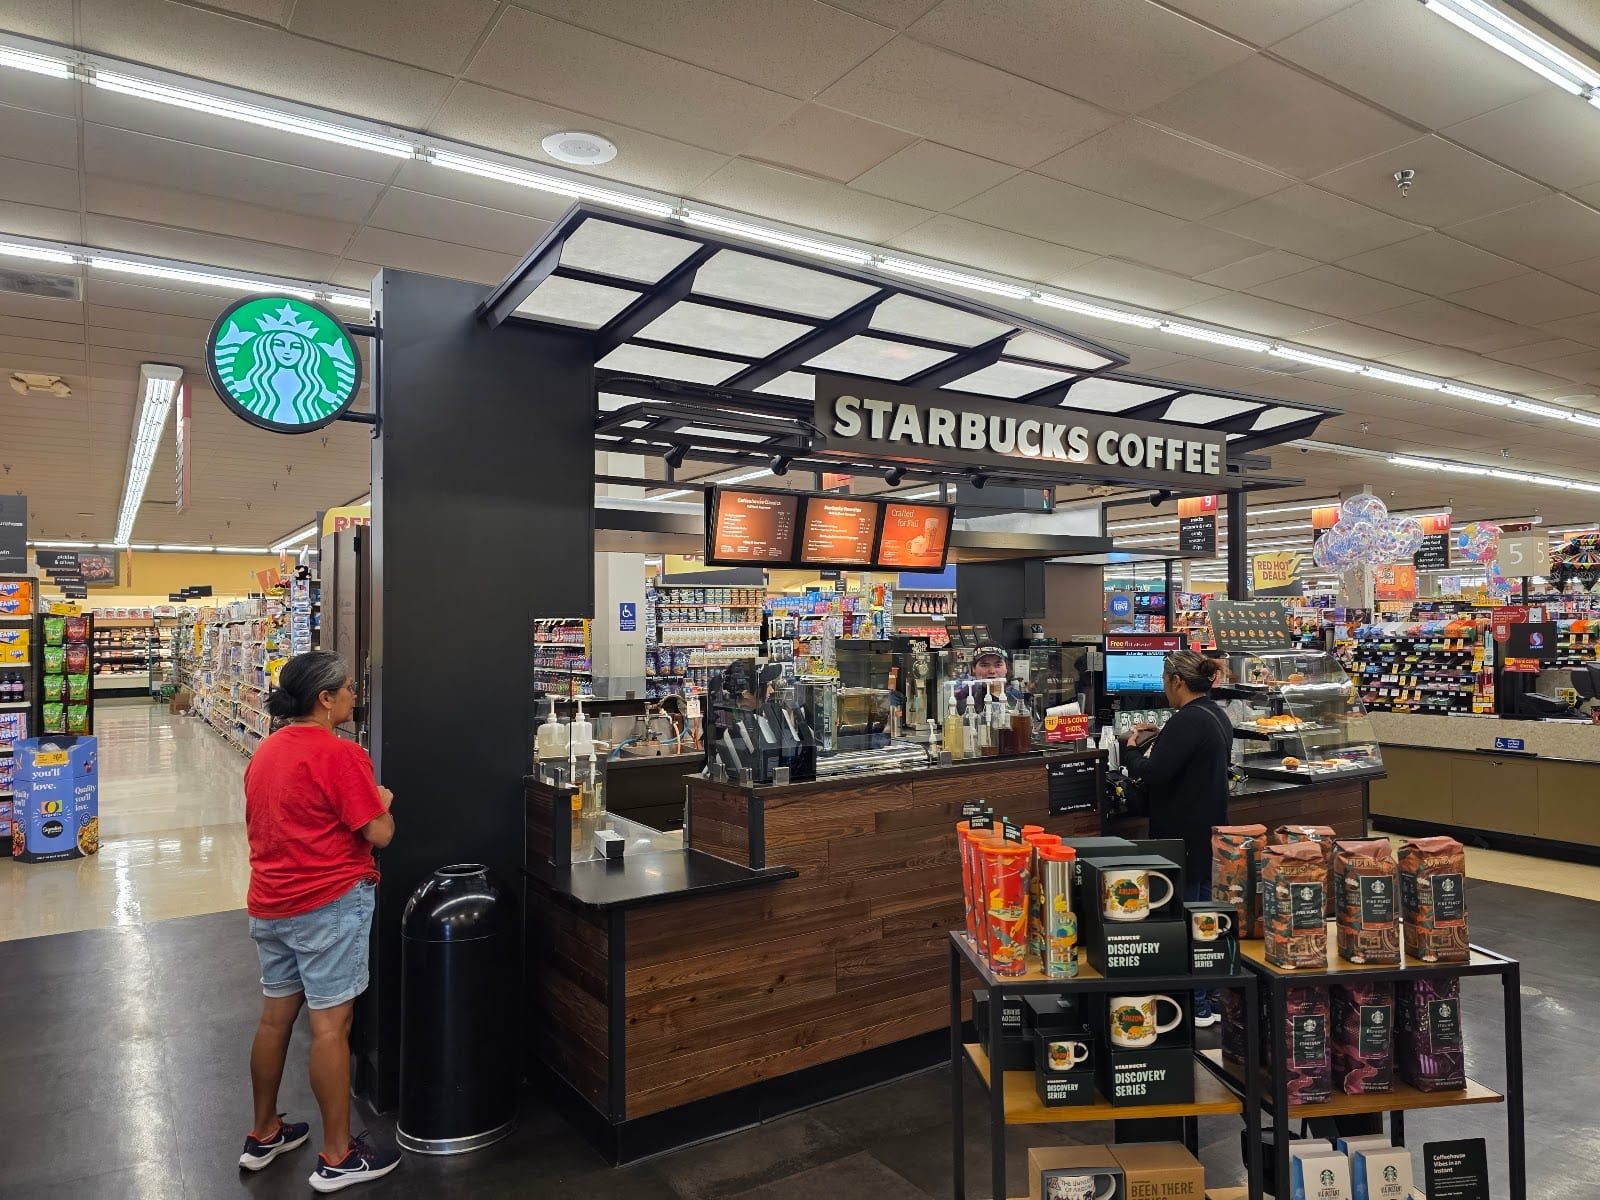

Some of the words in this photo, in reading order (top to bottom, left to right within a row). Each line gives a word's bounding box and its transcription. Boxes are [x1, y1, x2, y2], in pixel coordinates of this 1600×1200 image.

[833, 395, 1089, 463] STARBUCKS
[1096, 430, 1221, 475] COFFEE
[1204, 496, 1212, 506] 9
[335, 516, 371, 532] RE
[1436, 517, 1448, 528] 11
[1509, 543, 1524, 565] 5
[1537, 542, 1545, 564] 5
[1257, 561, 1272, 570] RED
[1273, 561, 1290, 571] HOT
[1262, 571, 1287, 580] DEALS
[1071, 716, 1088, 724] COVID
[32, 768, 60, 780] you'll
[32, 783, 57, 791] love.
[75, 784, 97, 795] Quality
[75, 793, 91, 804] you'll
[75, 804, 89, 812] love.
[1107, 942, 1160, 955] DISCOVERY
[1108, 956, 1140, 967] SERIES
[1194, 953, 1225, 961] DISCOVERY
[1194, 960, 1214, 968] SERIES
[1115, 1070, 1166, 1084] DISCOVERY
[1047, 1083, 1078, 1092] DISCOVERY
[1115, 1084, 1147, 1097] SERIES
[1047, 1091, 1067, 1099] SERIES
[1433, 1153, 1466, 1161] Coffeehouse
[1131, 1184, 1159, 1197] BEEN
[1161, 1182, 1194, 1195] THERE
